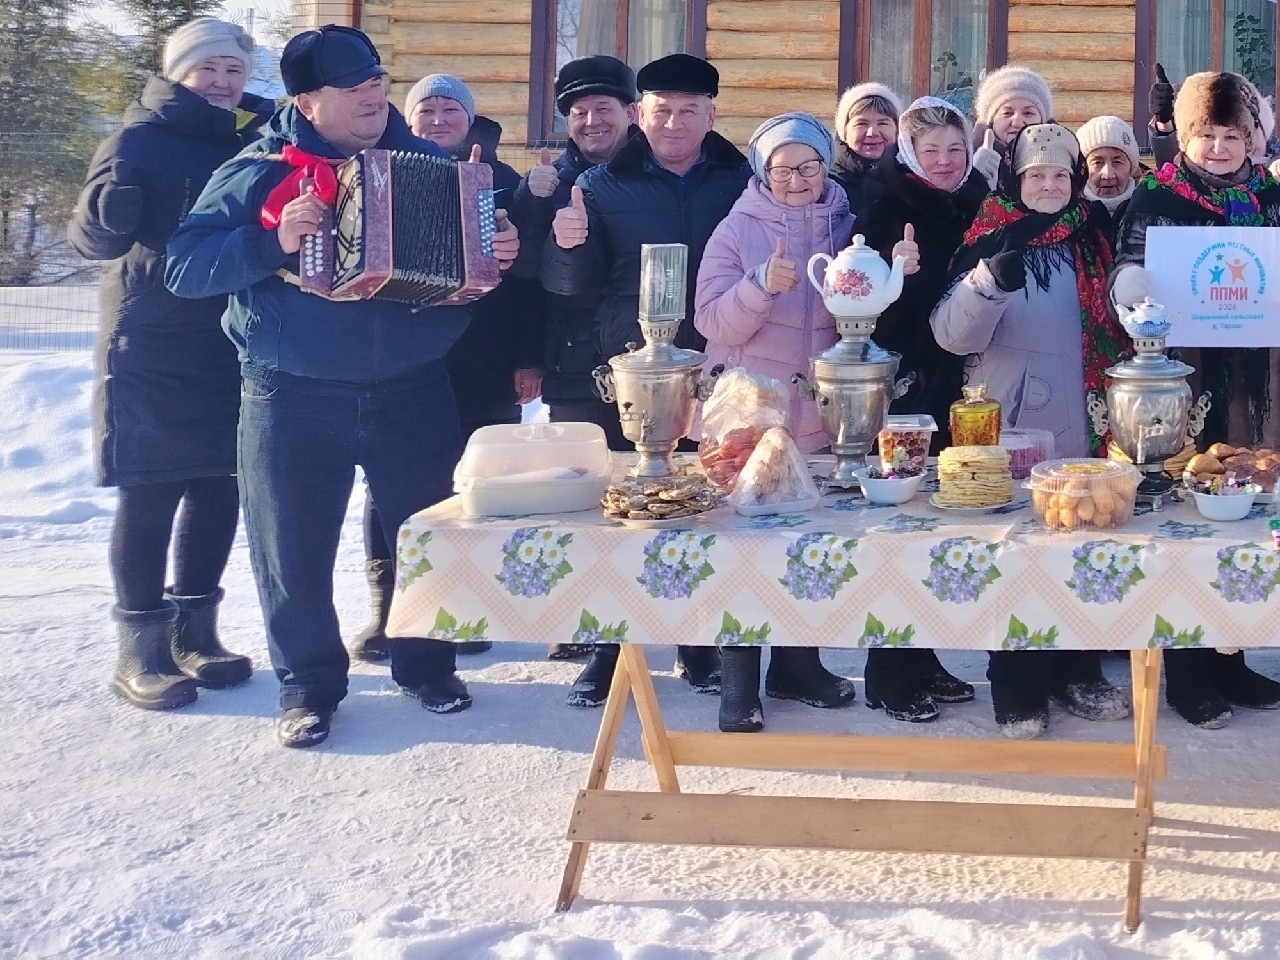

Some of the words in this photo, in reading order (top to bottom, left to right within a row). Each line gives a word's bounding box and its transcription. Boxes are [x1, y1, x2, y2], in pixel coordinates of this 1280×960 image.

[1194, 242, 1226, 269] ПОДДЕРЖКИ
[1228, 241, 1256, 257] МЕСТНЫХ
[1191, 270, 1199, 295] ПРОЕКТ
[1210, 287, 1248, 301] ППМИ
